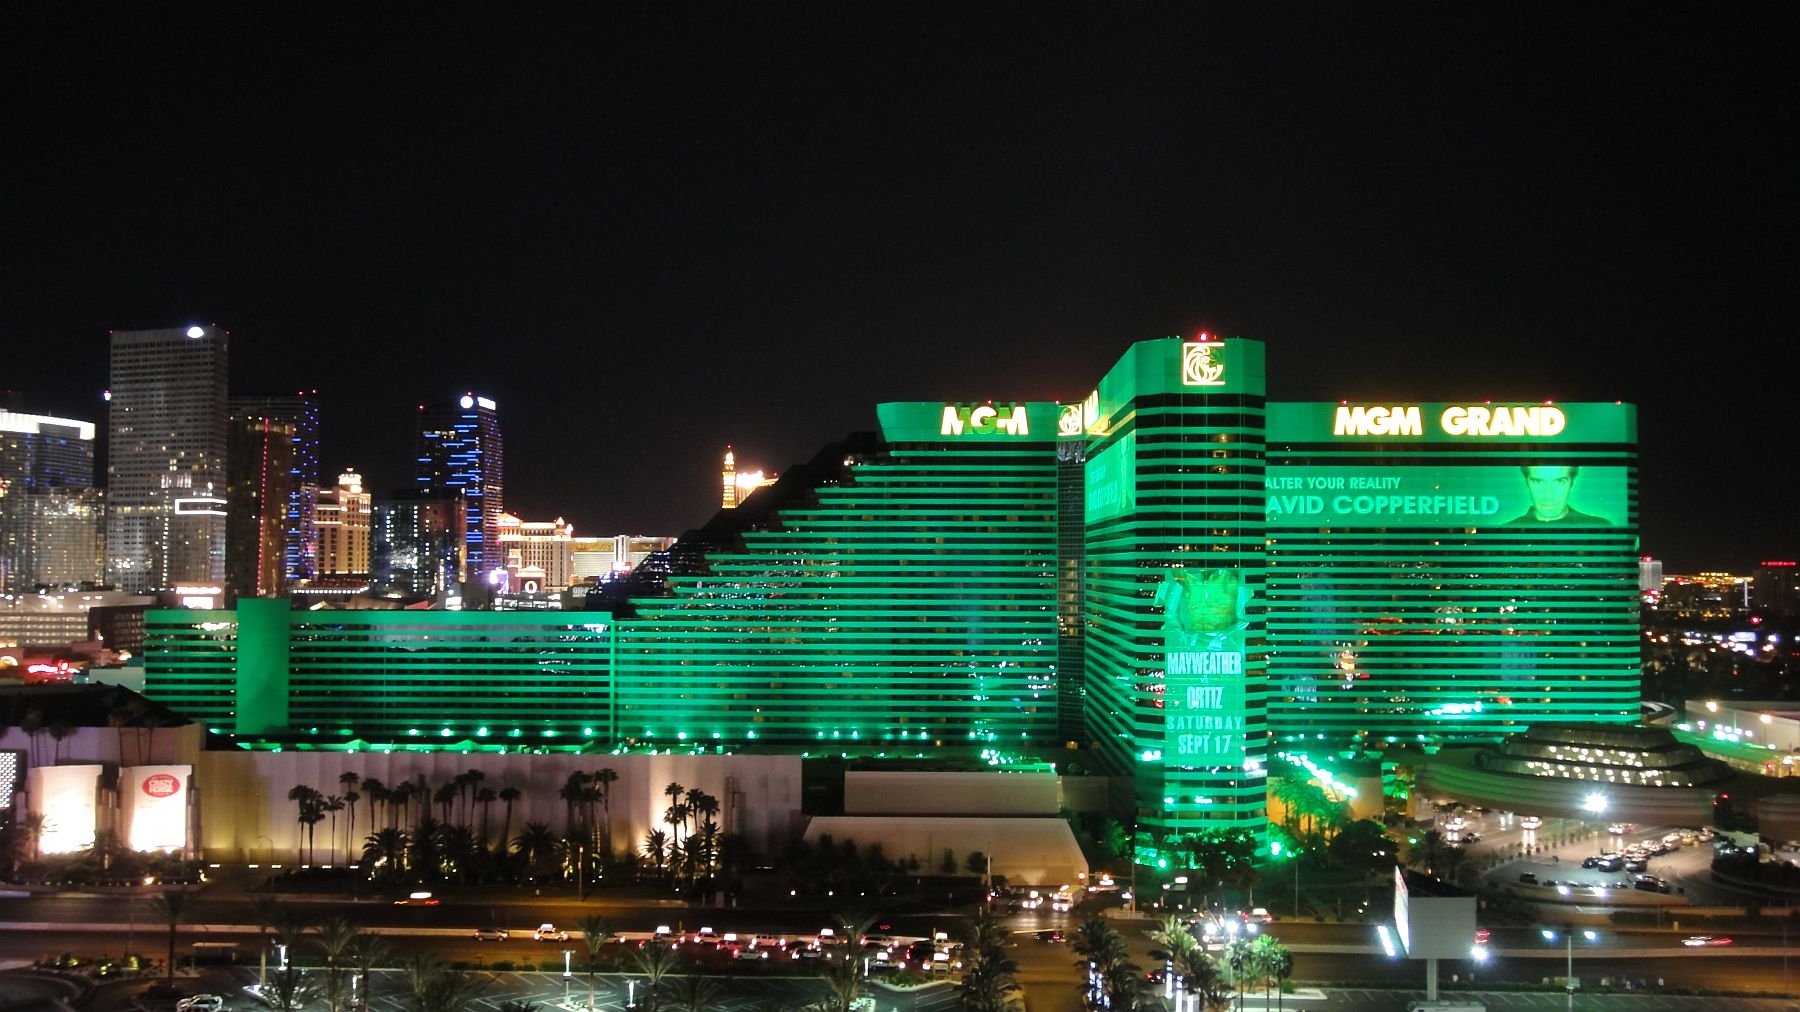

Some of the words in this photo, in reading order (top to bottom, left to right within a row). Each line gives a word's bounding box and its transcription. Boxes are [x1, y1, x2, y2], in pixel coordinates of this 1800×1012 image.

[941, 406, 1028, 435] MGM
[1334, 406, 1422, 435] MGM
[1441, 406, 1565, 436] GRAND
[1265, 477, 1303, 489] ALTER
[1307, 477, 1345, 489] YOUR
[1350, 477, 1401, 489] REALITY
[1333, 495, 1500, 515] COPPERFIELD
[1168, 652, 1242, 675] MAYWEATHER
[1187, 686, 1224, 709] ORTIZ
[1167, 716, 1241, 729] SATURDAY
[1178, 734, 1210, 754] SEPT
[1215, 735, 1232, 754] 17
